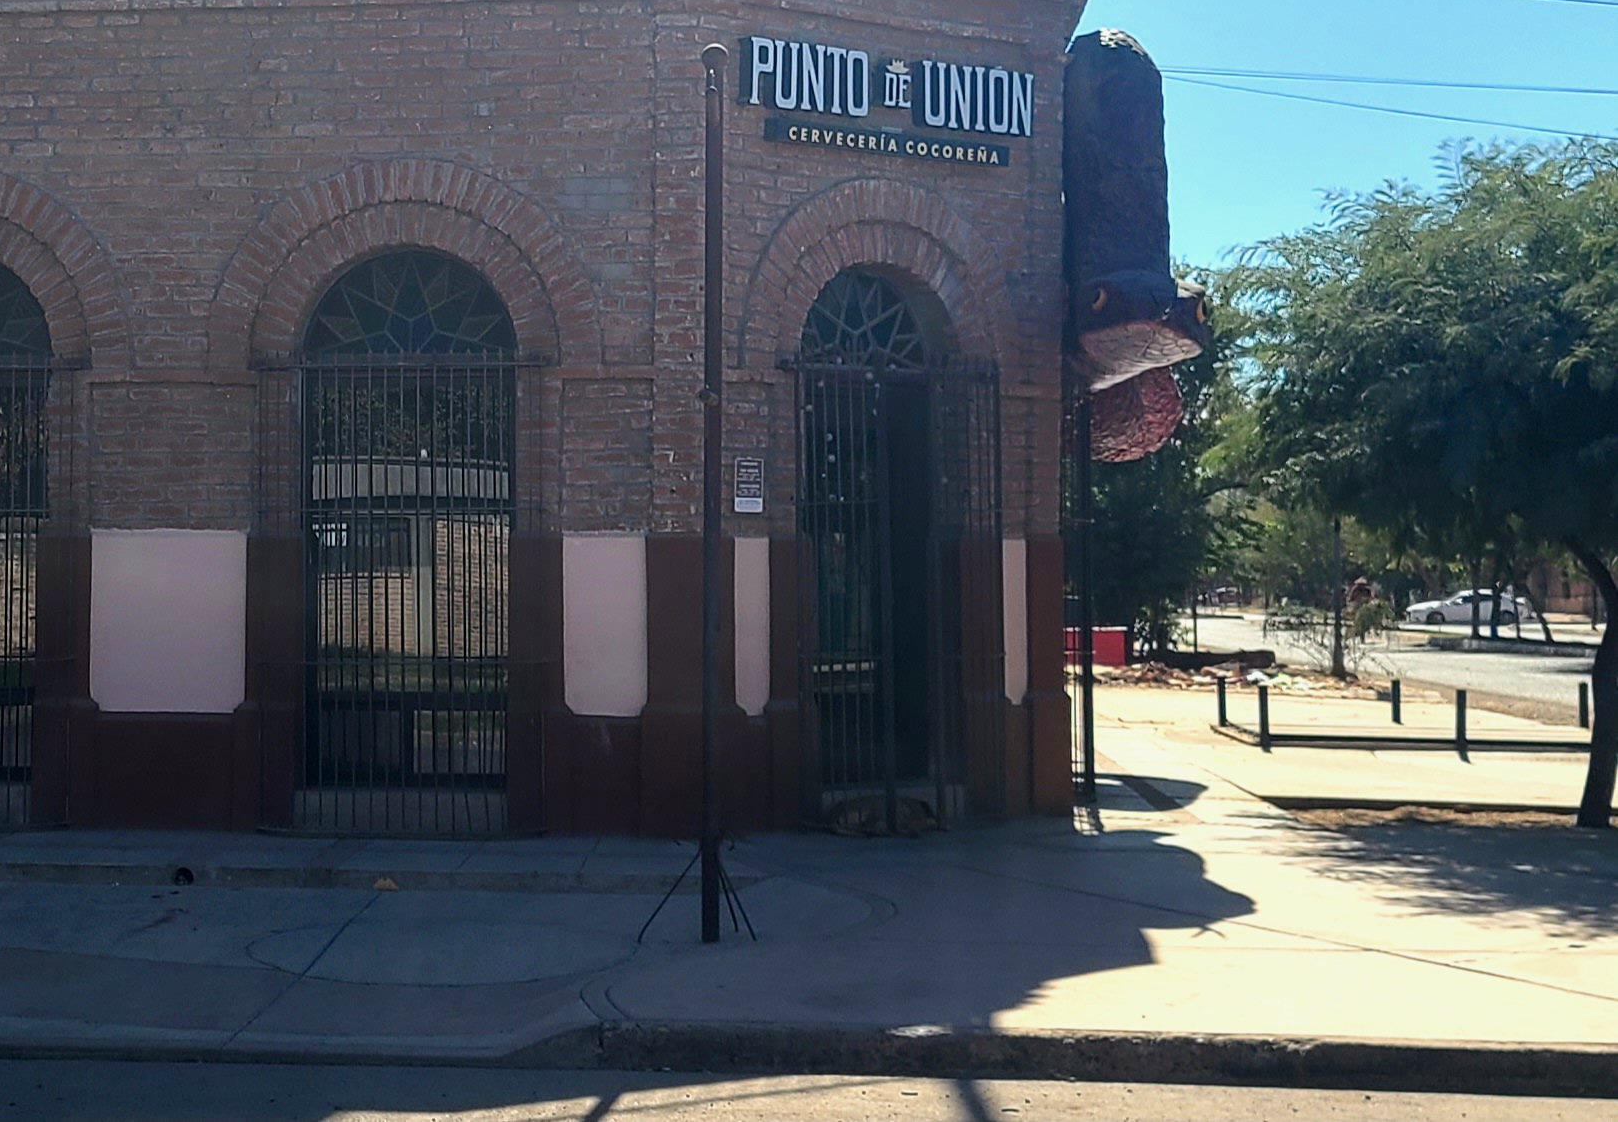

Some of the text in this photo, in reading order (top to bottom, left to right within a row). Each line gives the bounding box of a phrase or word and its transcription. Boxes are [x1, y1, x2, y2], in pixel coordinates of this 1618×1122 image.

[749, 36, 1034, 137] PUNTO DE UNIÓN
[788, 126, 1000, 165] CERVECERÍA COCOREÑA
